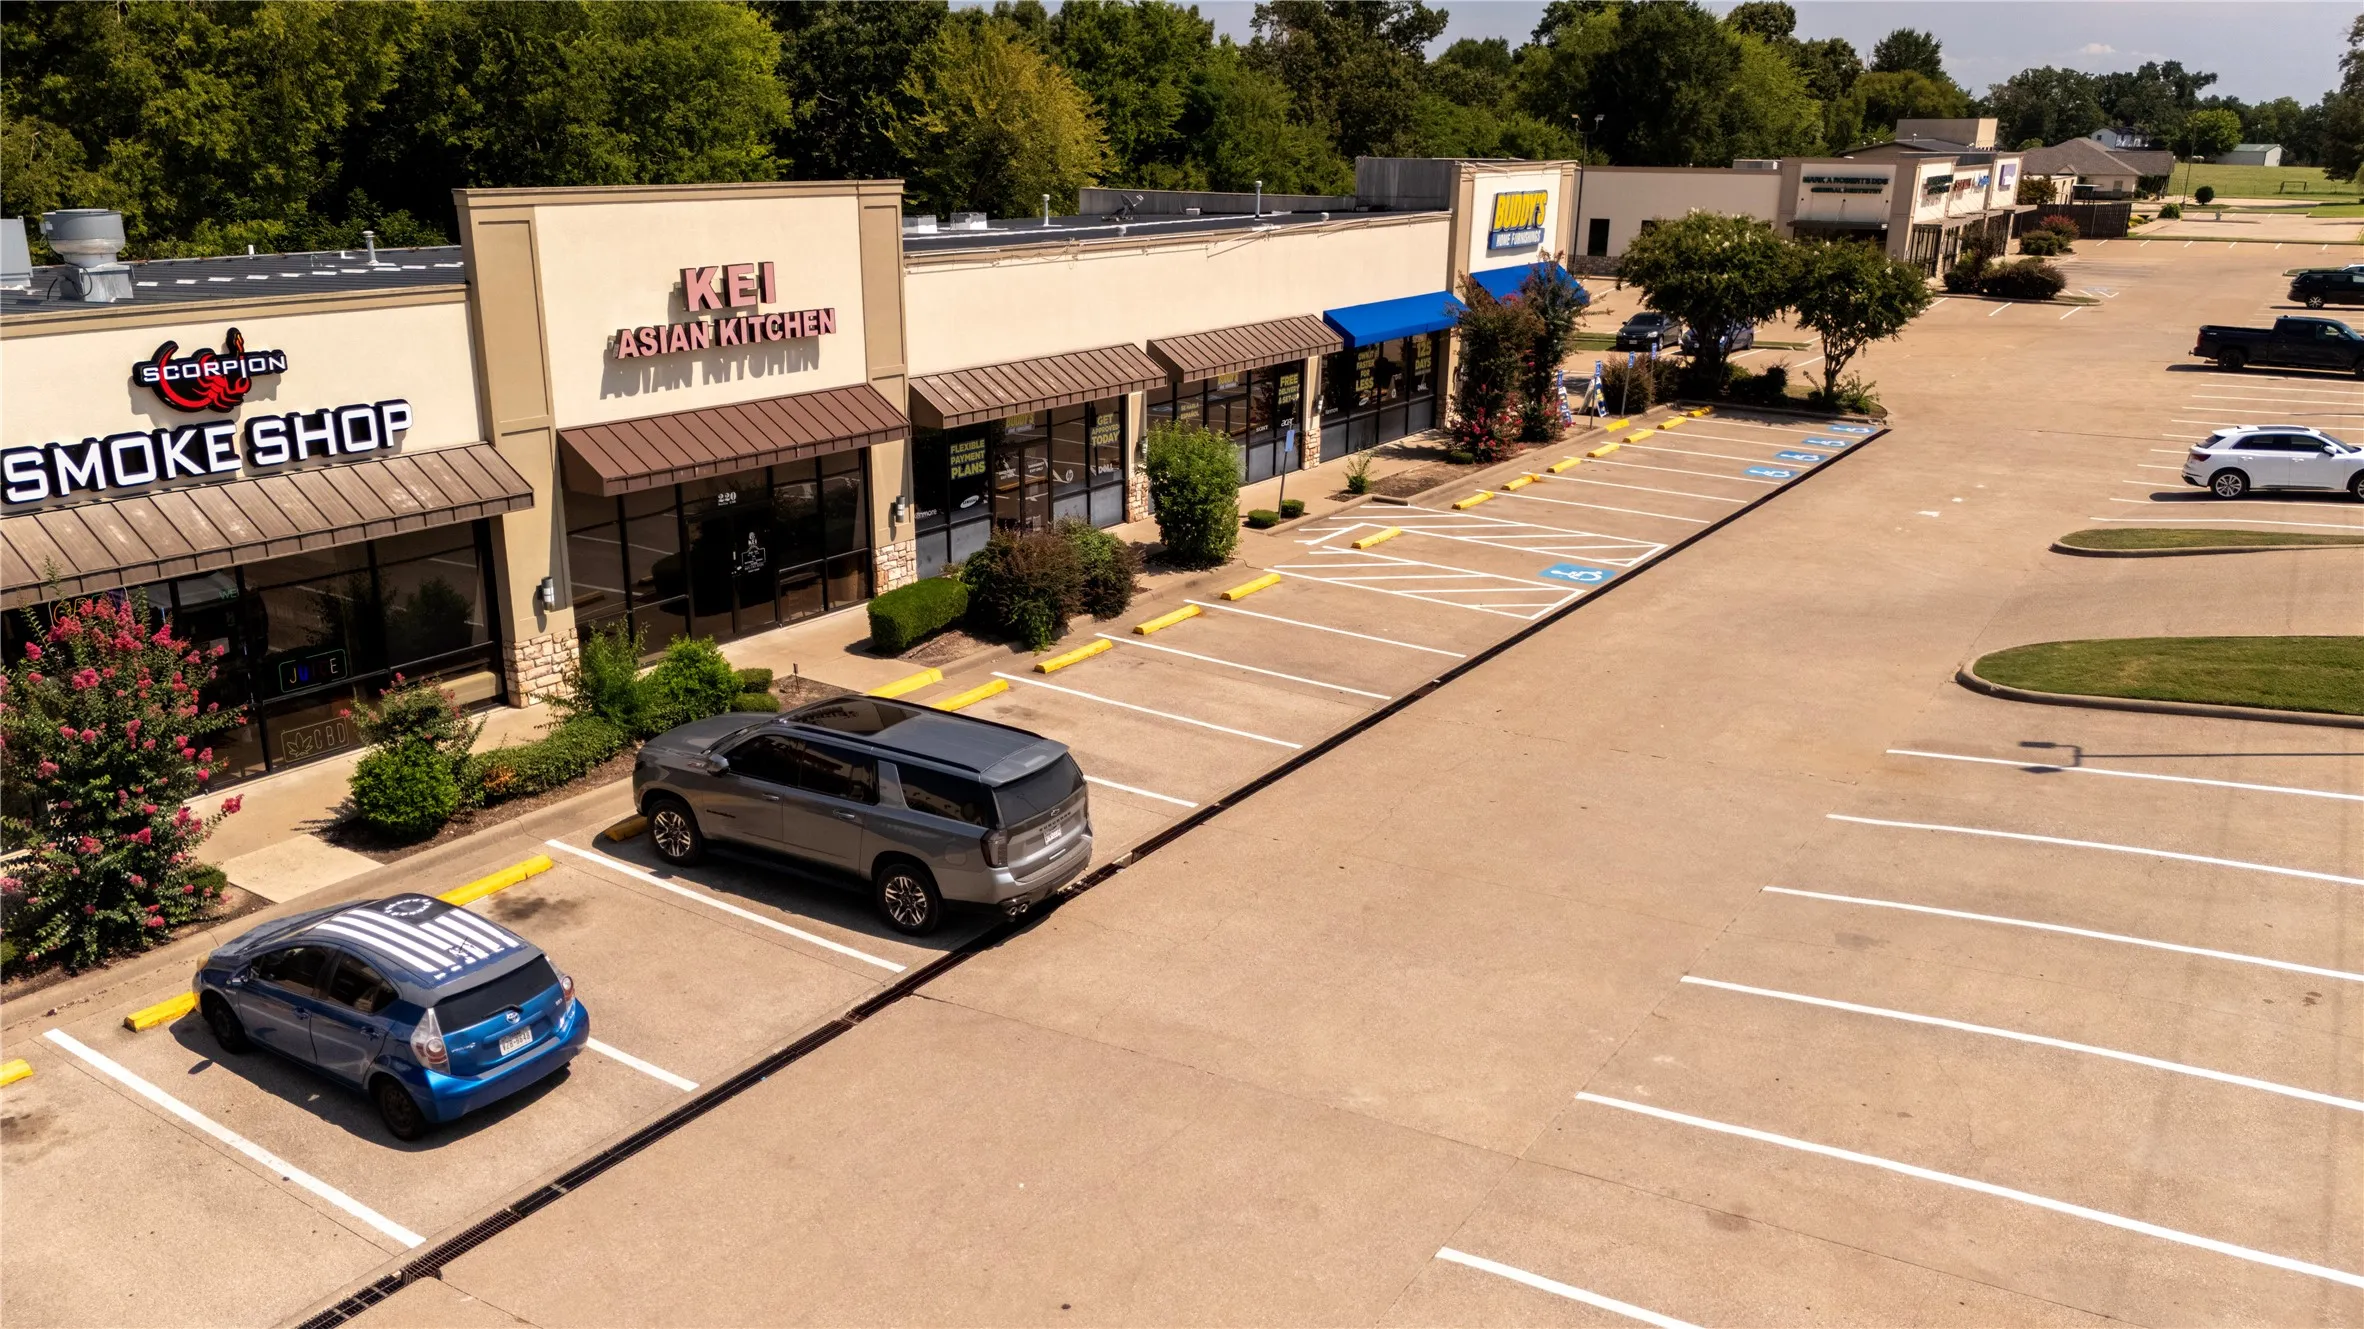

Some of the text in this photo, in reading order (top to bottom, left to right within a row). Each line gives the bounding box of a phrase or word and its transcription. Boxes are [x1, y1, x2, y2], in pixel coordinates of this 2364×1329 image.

[1493, 191, 1547, 230] BUDDY'S
[1496, 230, 1542, 247] HOME FURNISHINGS
[683, 262, 777, 312] KEI
[616, 308, 836, 360] ASIAN KITCHEN
[142, 355, 287, 382] SCORPION
[1280, 373, 1299, 388] FREE
[1355, 377, 1374, 392] LESS
[1097, 413, 1114, 426] GET
[950, 438, 985, 454] FLEXIBLE
[1091, 431, 1120, 448] TODAY
[3, 402, 414, 503] SMOKE SHOP
[950, 450, 985, 466] PAYMENT
[951, 461, 986, 480] PLANS
[718, 491, 737, 503] 220
[313, 722, 346, 749] CBD
